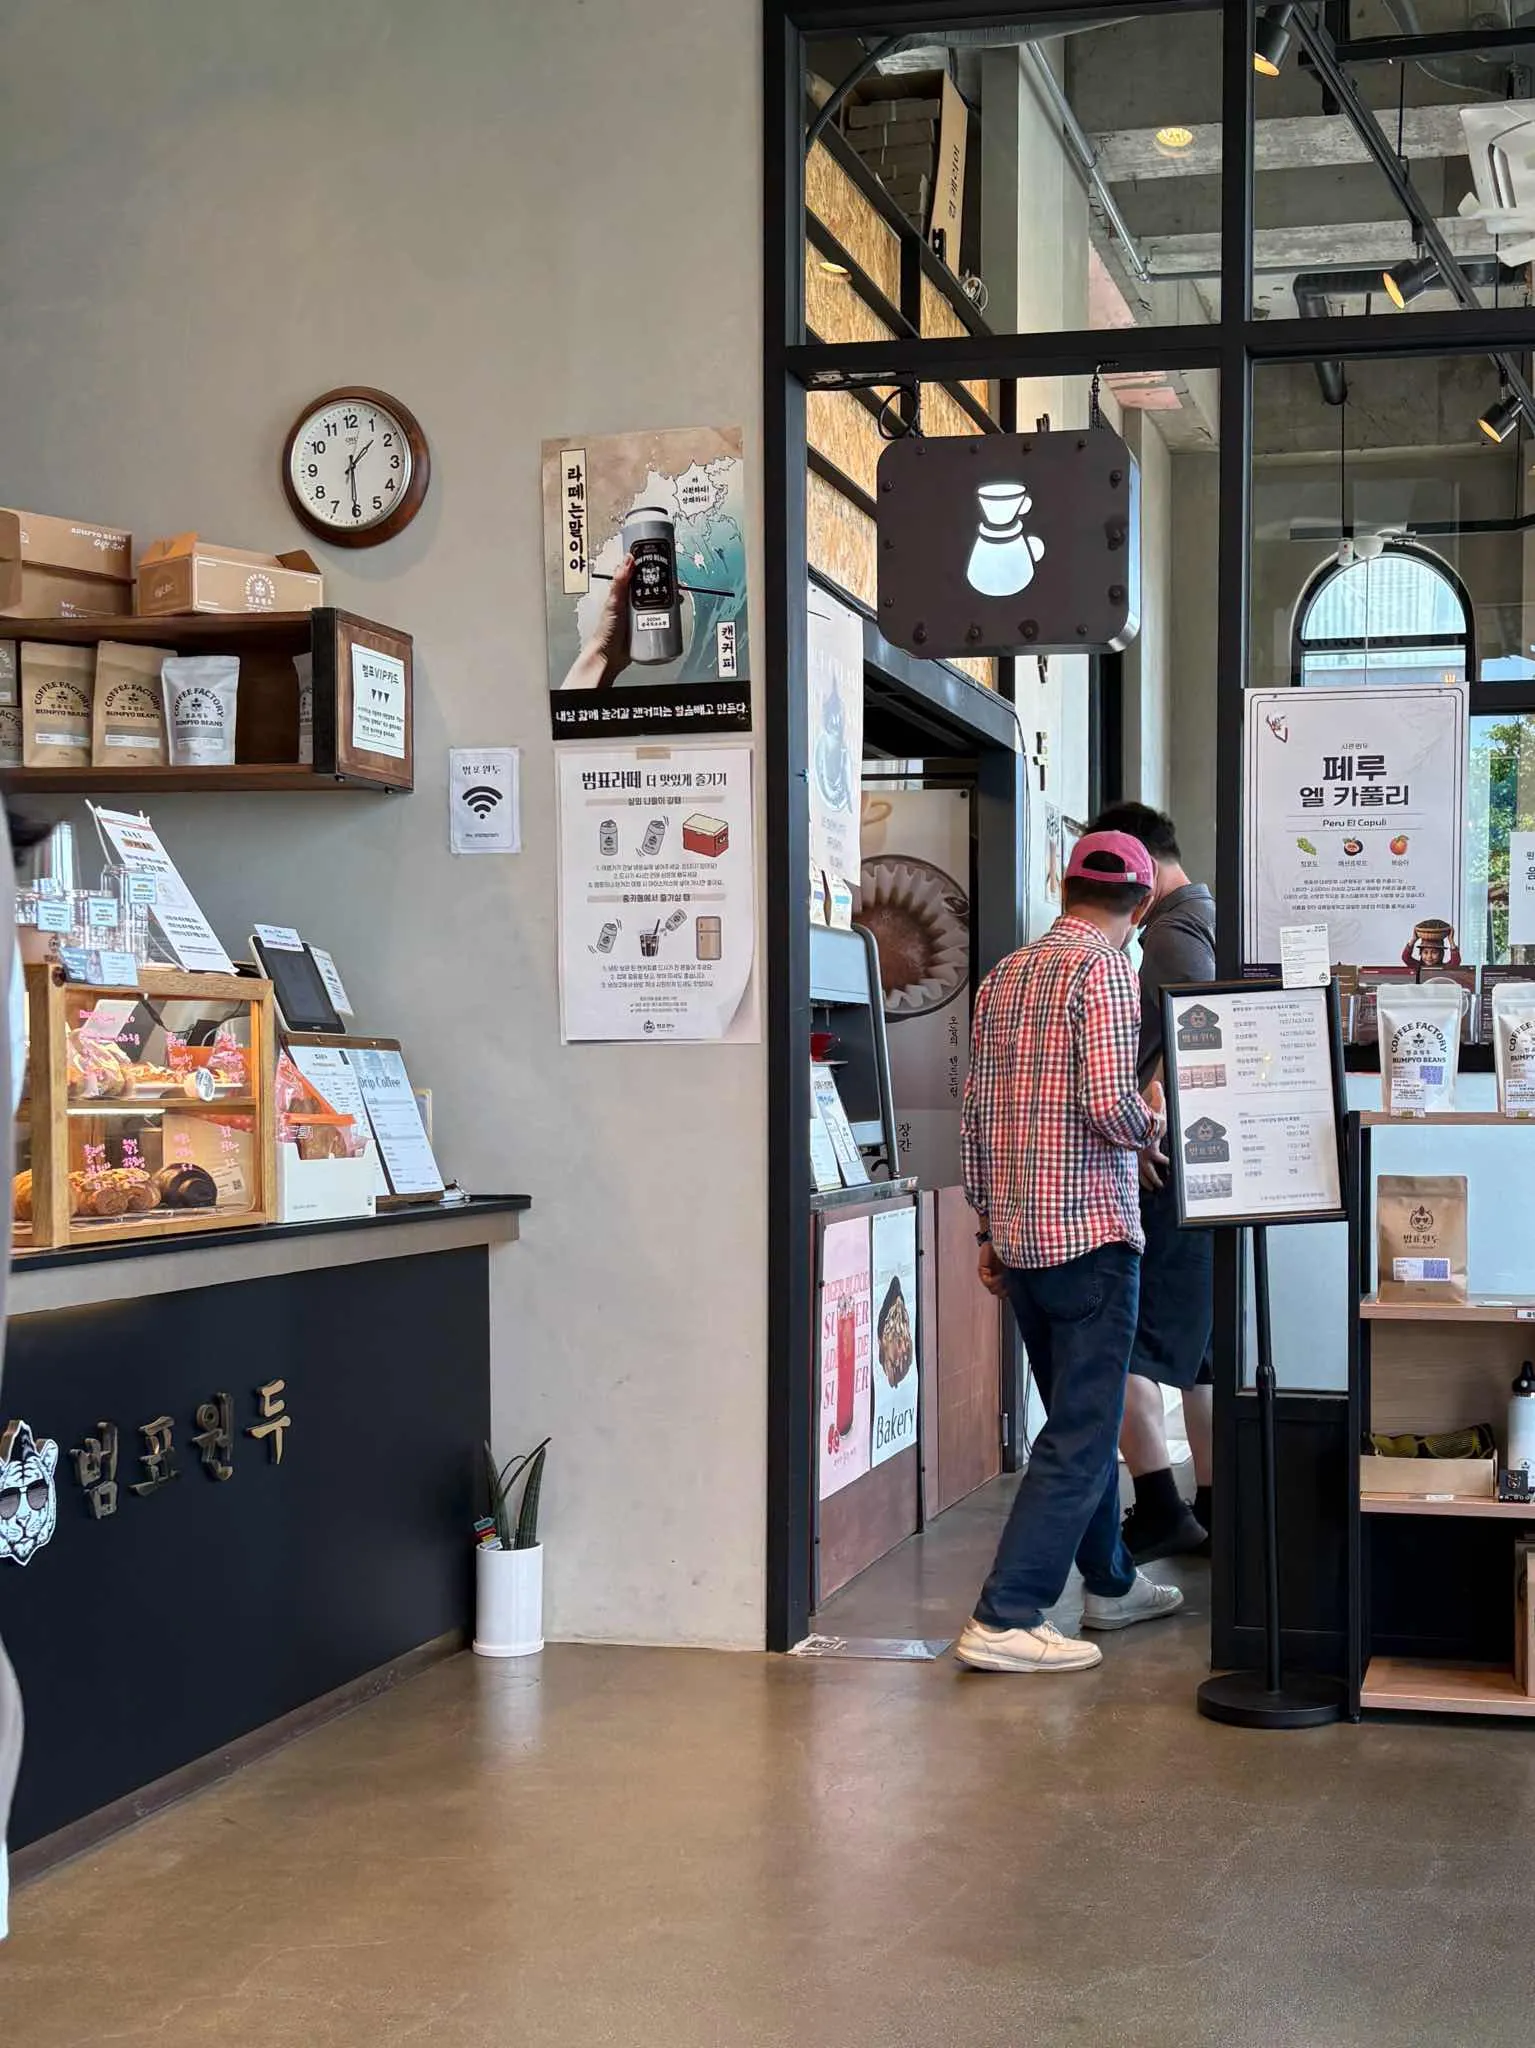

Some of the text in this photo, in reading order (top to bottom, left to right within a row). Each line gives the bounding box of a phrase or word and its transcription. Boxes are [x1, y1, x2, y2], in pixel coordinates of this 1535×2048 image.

[343, 414, 358, 429] 12
[368, 418, 375, 432] 1
[324, 422, 338, 437] 11
[311, 440, 326, 455] 10
[383, 433, 393, 448] 2
[390, 455, 400, 469] 3
[308, 463, 318, 478] 9
[315, 485, 326, 499] 8
[384, 478, 396, 491] 4
[330, 500, 340, 514] 7
[372, 495, 382, 510] 5
[351, 503, 362, 518] 6
[567, 464, 587, 573] 라떼는말이야
[721, 625, 735, 670] 캔커피
[1323, 755, 1387, 781] 페루
[582, 770, 727, 790] 범표라떼 더 맛있게 즐기기
[1300, 785, 1409, 807] 엘 카풀리
[1322, 818, 1345, 827] Peru
[1391, 1021, 1447, 1053] COFFEE FACTORY
[1509, 1022, 1533, 1052] COFFEE
[377, 1076, 401, 1088] Coffee
[876, 1406, 915, 1450] Bakery
